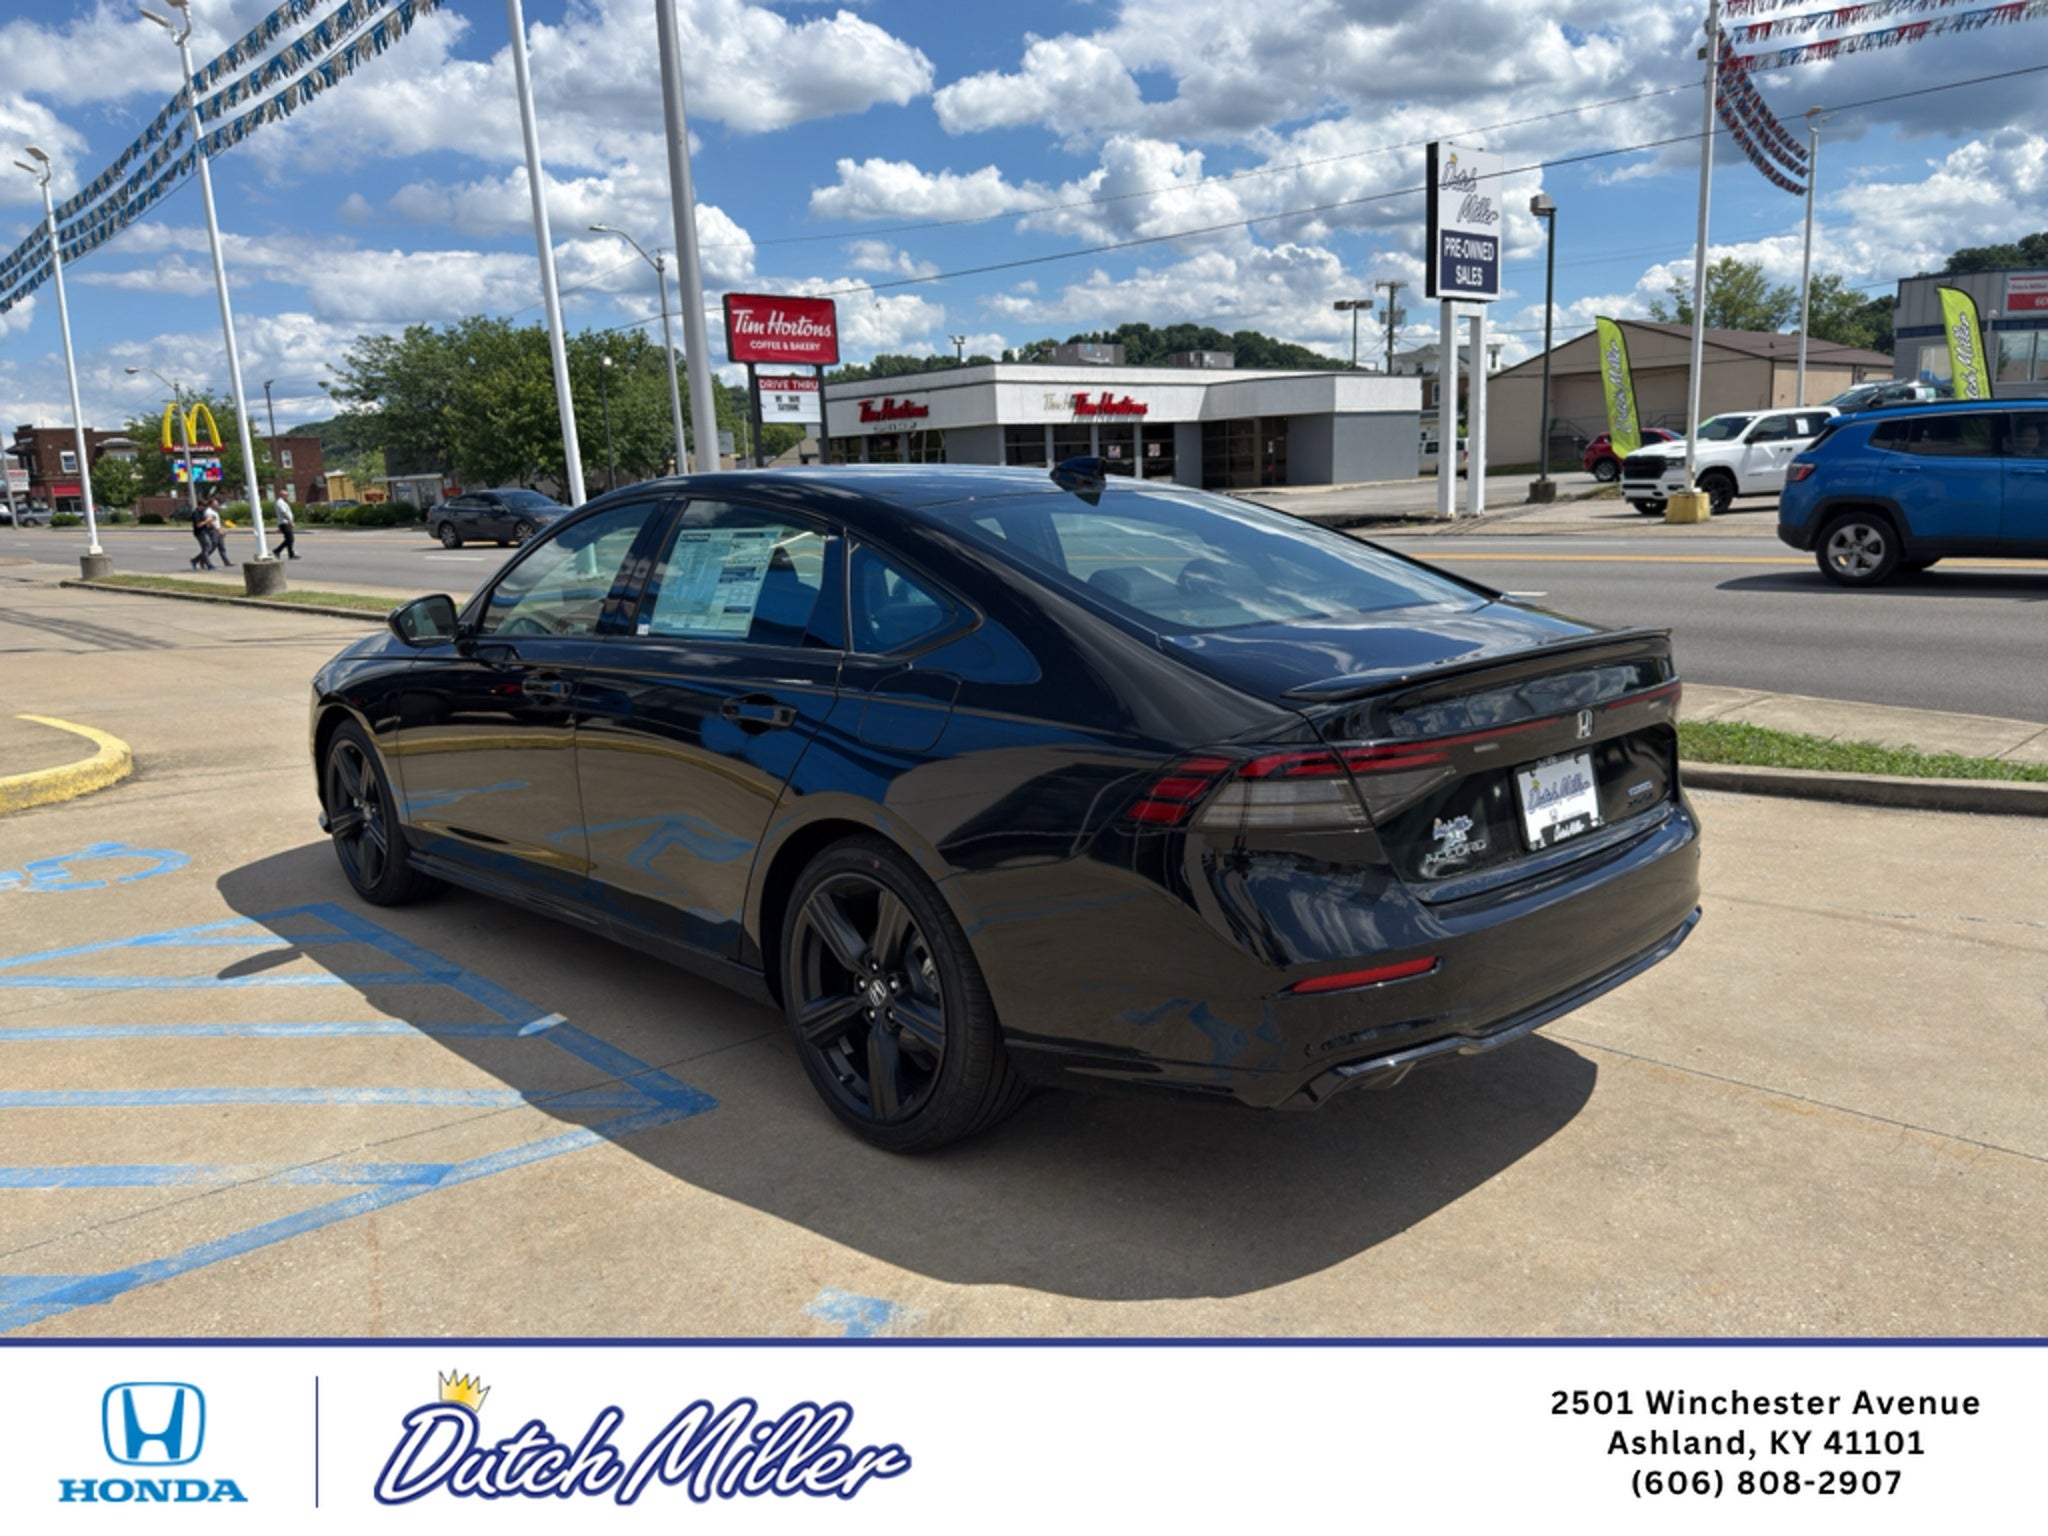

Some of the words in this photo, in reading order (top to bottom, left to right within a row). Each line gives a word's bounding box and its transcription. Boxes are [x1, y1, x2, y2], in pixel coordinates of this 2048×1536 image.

[1443, 237, 1495, 262] PRE-OWNED
[1455, 265, 1483, 286] SALES
[732, 309, 765, 334] Tim
[767, 309, 832, 337] Hortons
[749, 339, 781, 351] COFFEE
[782, 341, 789, 351] &
[790, 341, 822, 352] BAKERY
[759, 379, 789, 390] DRIVE
[793, 380, 819, 390] THRU
